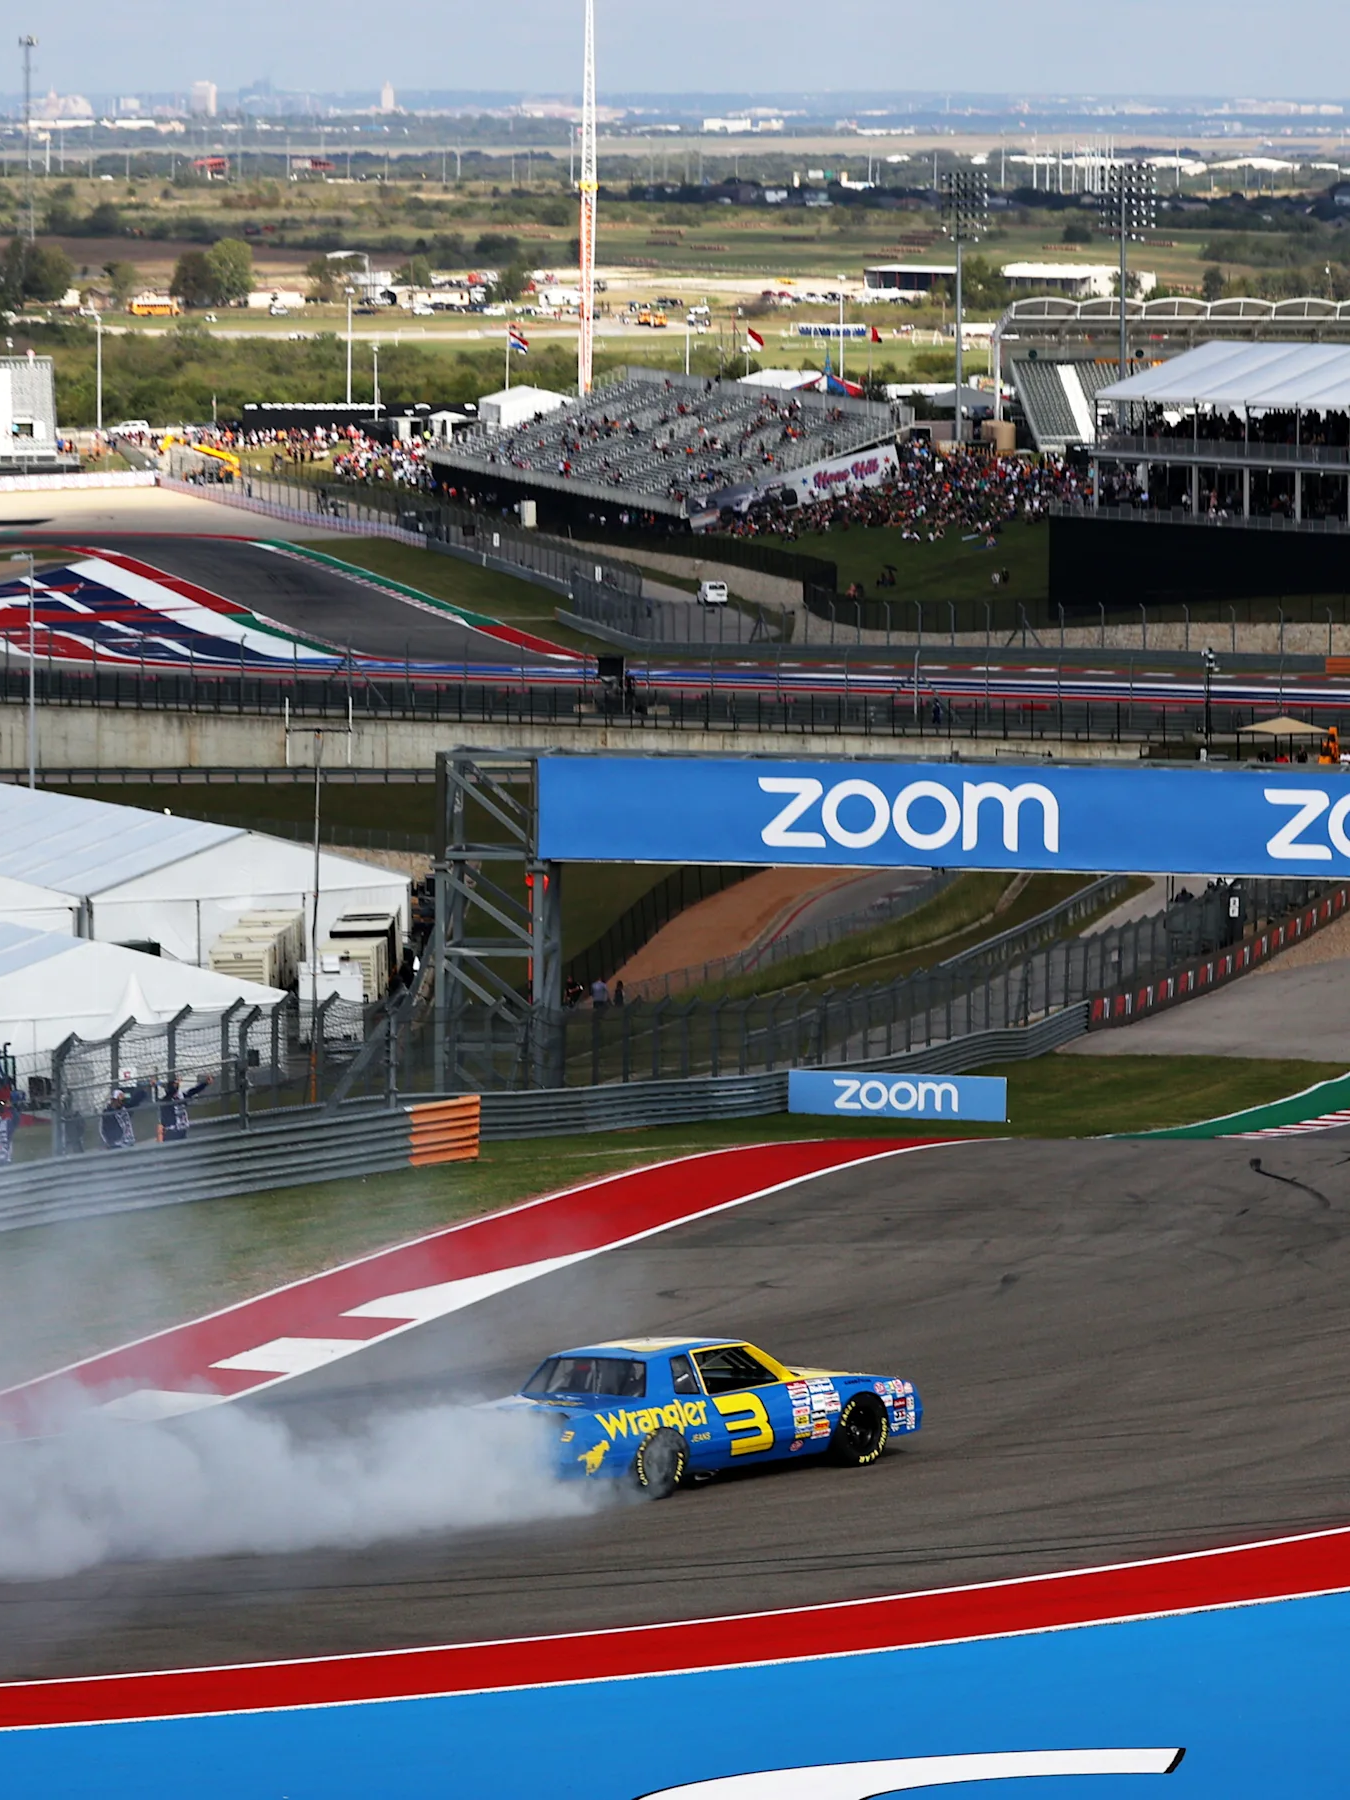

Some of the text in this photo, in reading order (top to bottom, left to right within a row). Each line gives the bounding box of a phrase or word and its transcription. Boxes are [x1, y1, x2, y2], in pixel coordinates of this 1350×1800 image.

[758, 777, 1059, 853] zoom
[833, 1079, 959, 1112] zoom
[594, 1399, 708, 1441] Wrangler
[712, 1392, 774, 1457] 3
